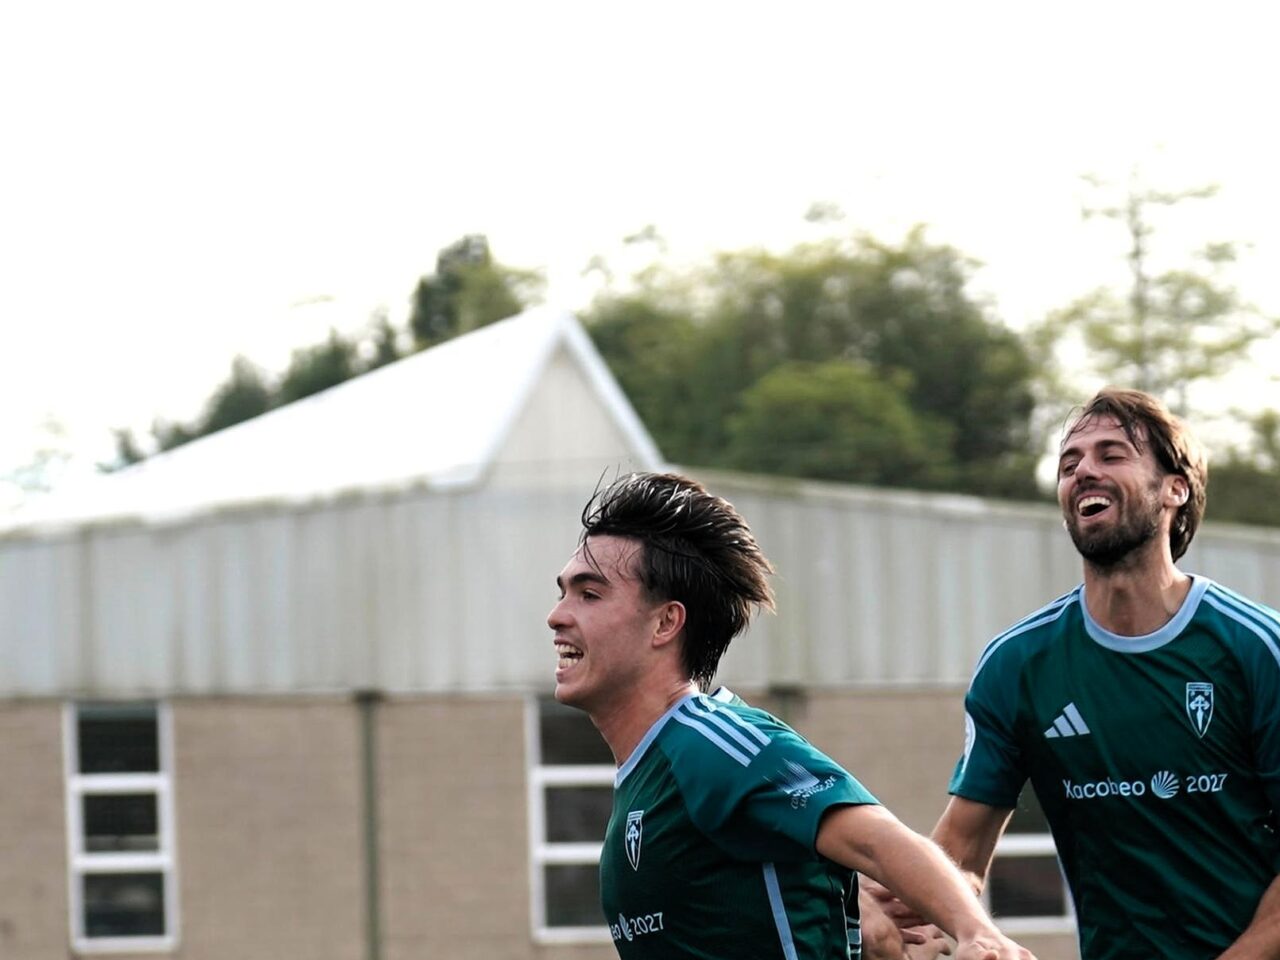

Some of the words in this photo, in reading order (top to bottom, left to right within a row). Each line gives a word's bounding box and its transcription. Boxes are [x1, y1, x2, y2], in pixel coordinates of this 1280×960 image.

[1062, 777, 1146, 800] Xacobeo
[1185, 772, 1229, 794] 2027
[629, 911, 664, 935] 2027
